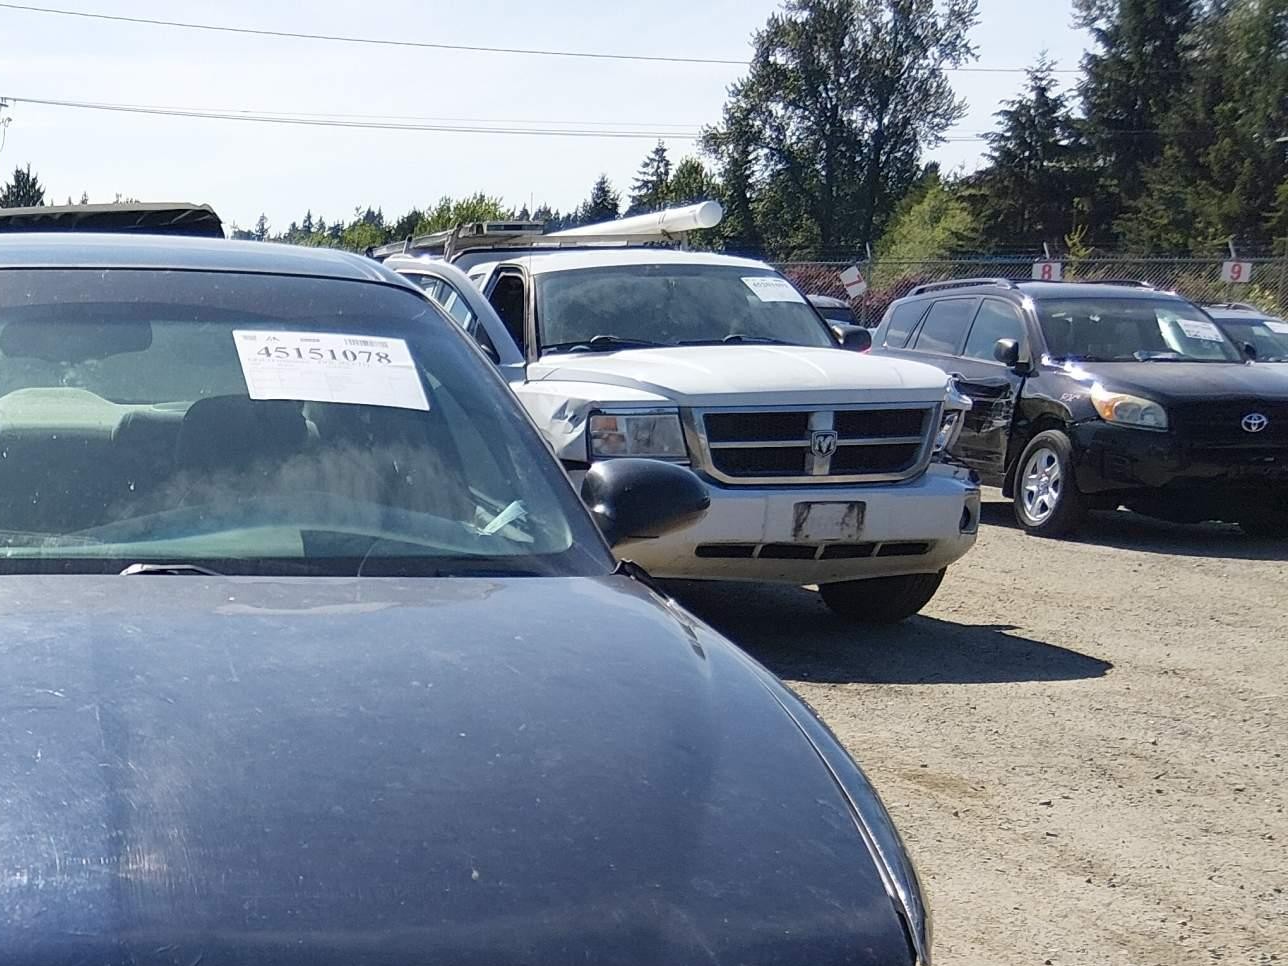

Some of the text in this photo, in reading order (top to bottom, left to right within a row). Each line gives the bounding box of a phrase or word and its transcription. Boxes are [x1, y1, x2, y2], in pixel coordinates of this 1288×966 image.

[1041, 264, 1053, 281] 8
[1229, 262, 1242, 281] 9
[256, 345, 393, 364] 45151078
